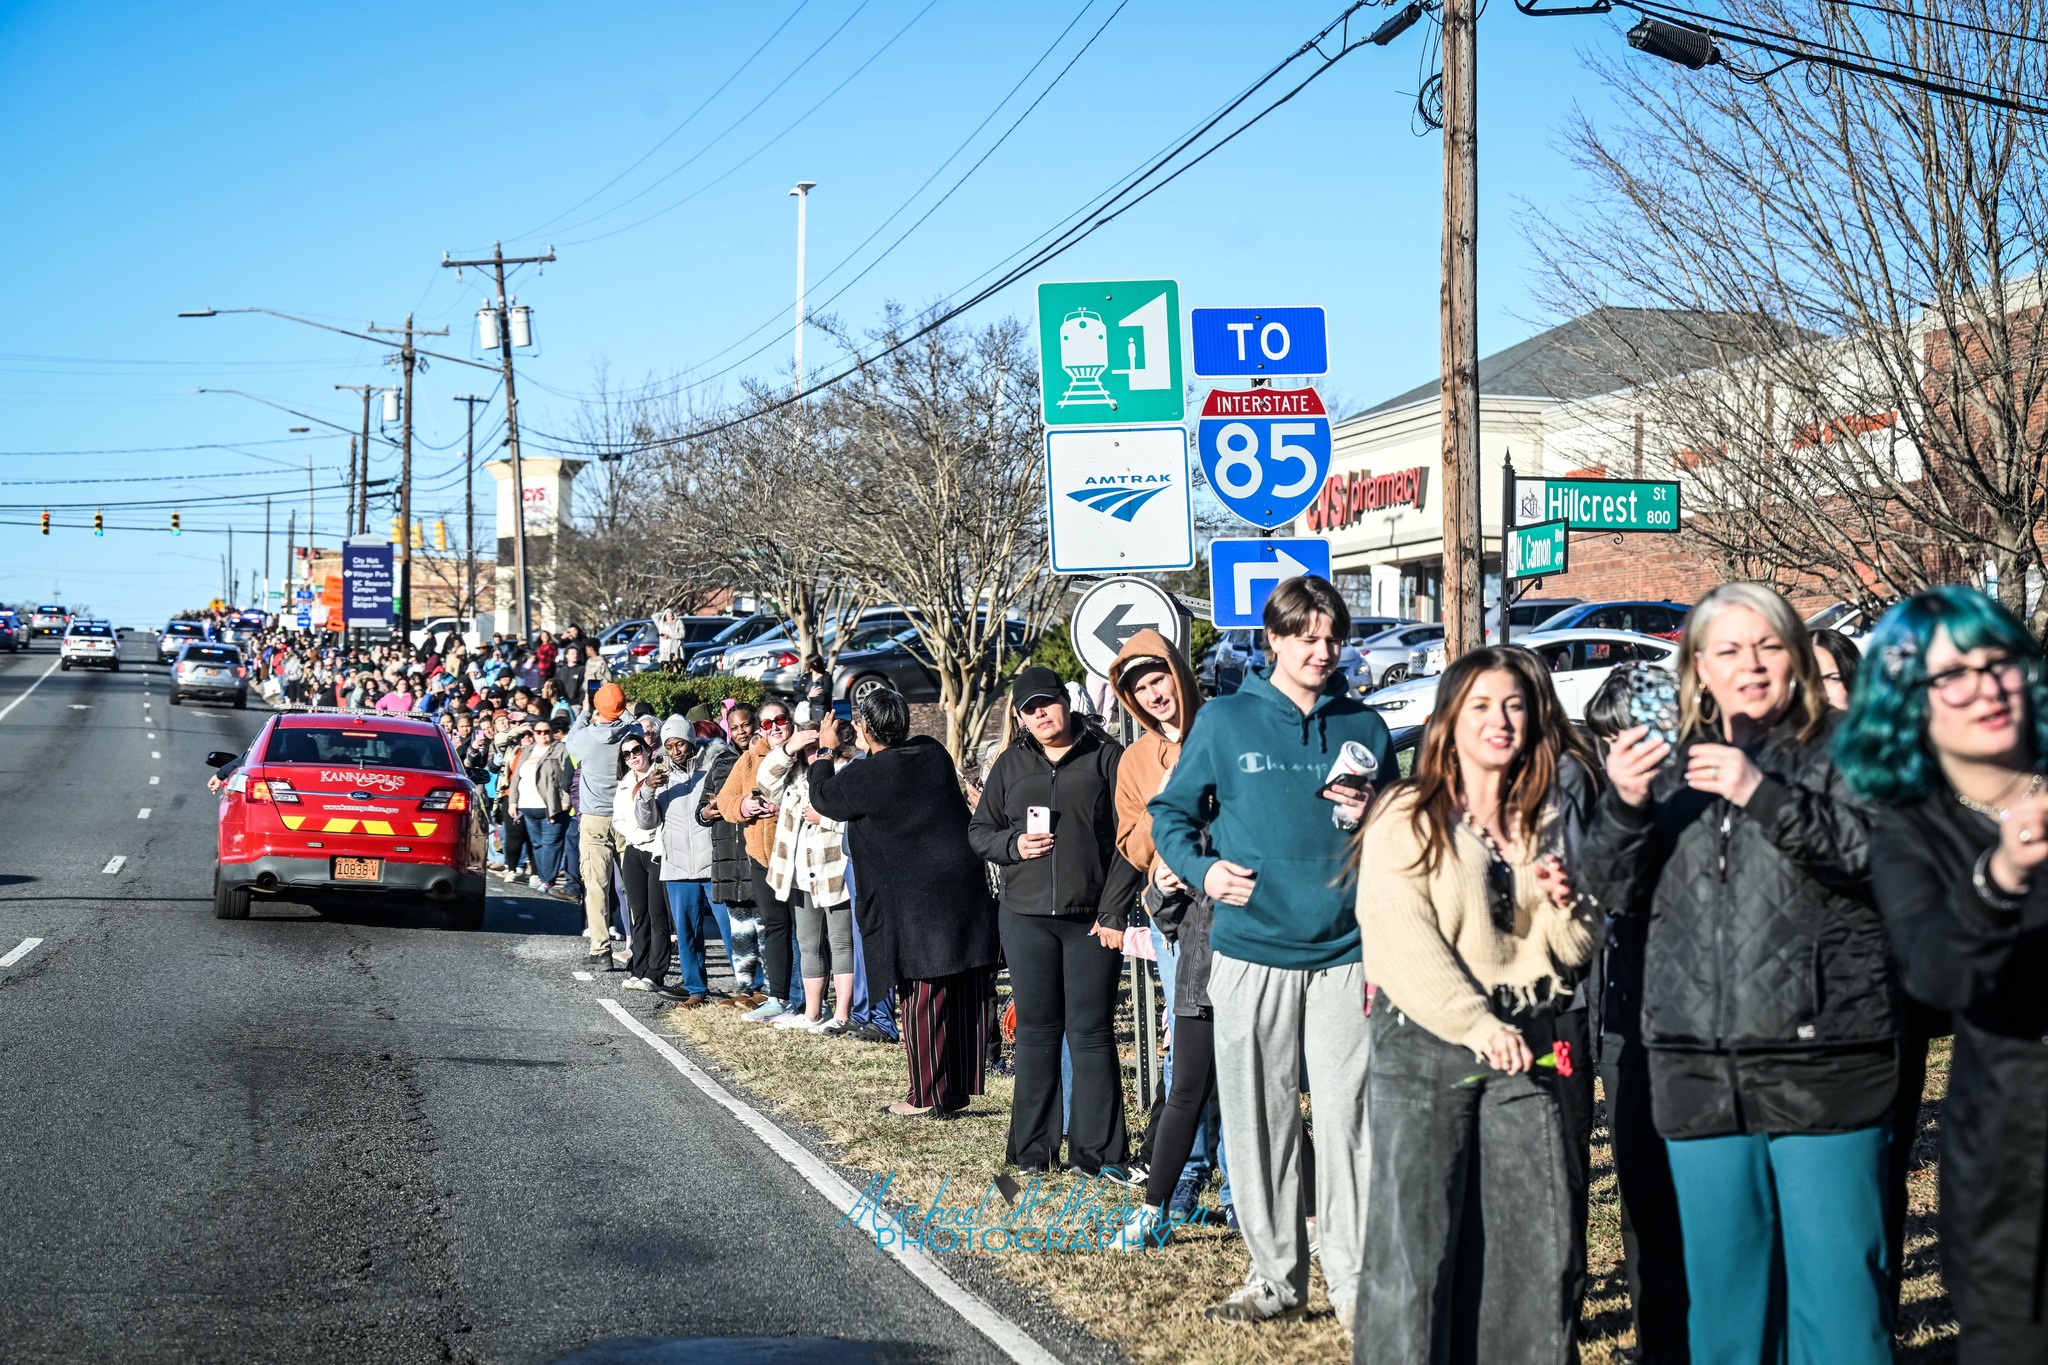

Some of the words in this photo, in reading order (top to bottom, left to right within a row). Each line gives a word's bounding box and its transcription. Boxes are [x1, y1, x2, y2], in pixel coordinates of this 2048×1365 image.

[1227, 322, 1290, 361] TO
[1217, 395, 1309, 413] INTERSTATE
[1214, 422, 1318, 499] 85
[1085, 474, 1171, 485] AMTRAK
[1653, 487, 1666, 501] St
[1549, 487, 1637, 523] Hillcrest
[1647, 511, 1671, 525] 800
[352, 556, 365, 565] City
[1516, 536, 1524, 571] N.
[1526, 534, 1551, 569] Cannon
[353, 571, 374, 579] Village
[320, 770, 406, 792] KANNAPOLIS
